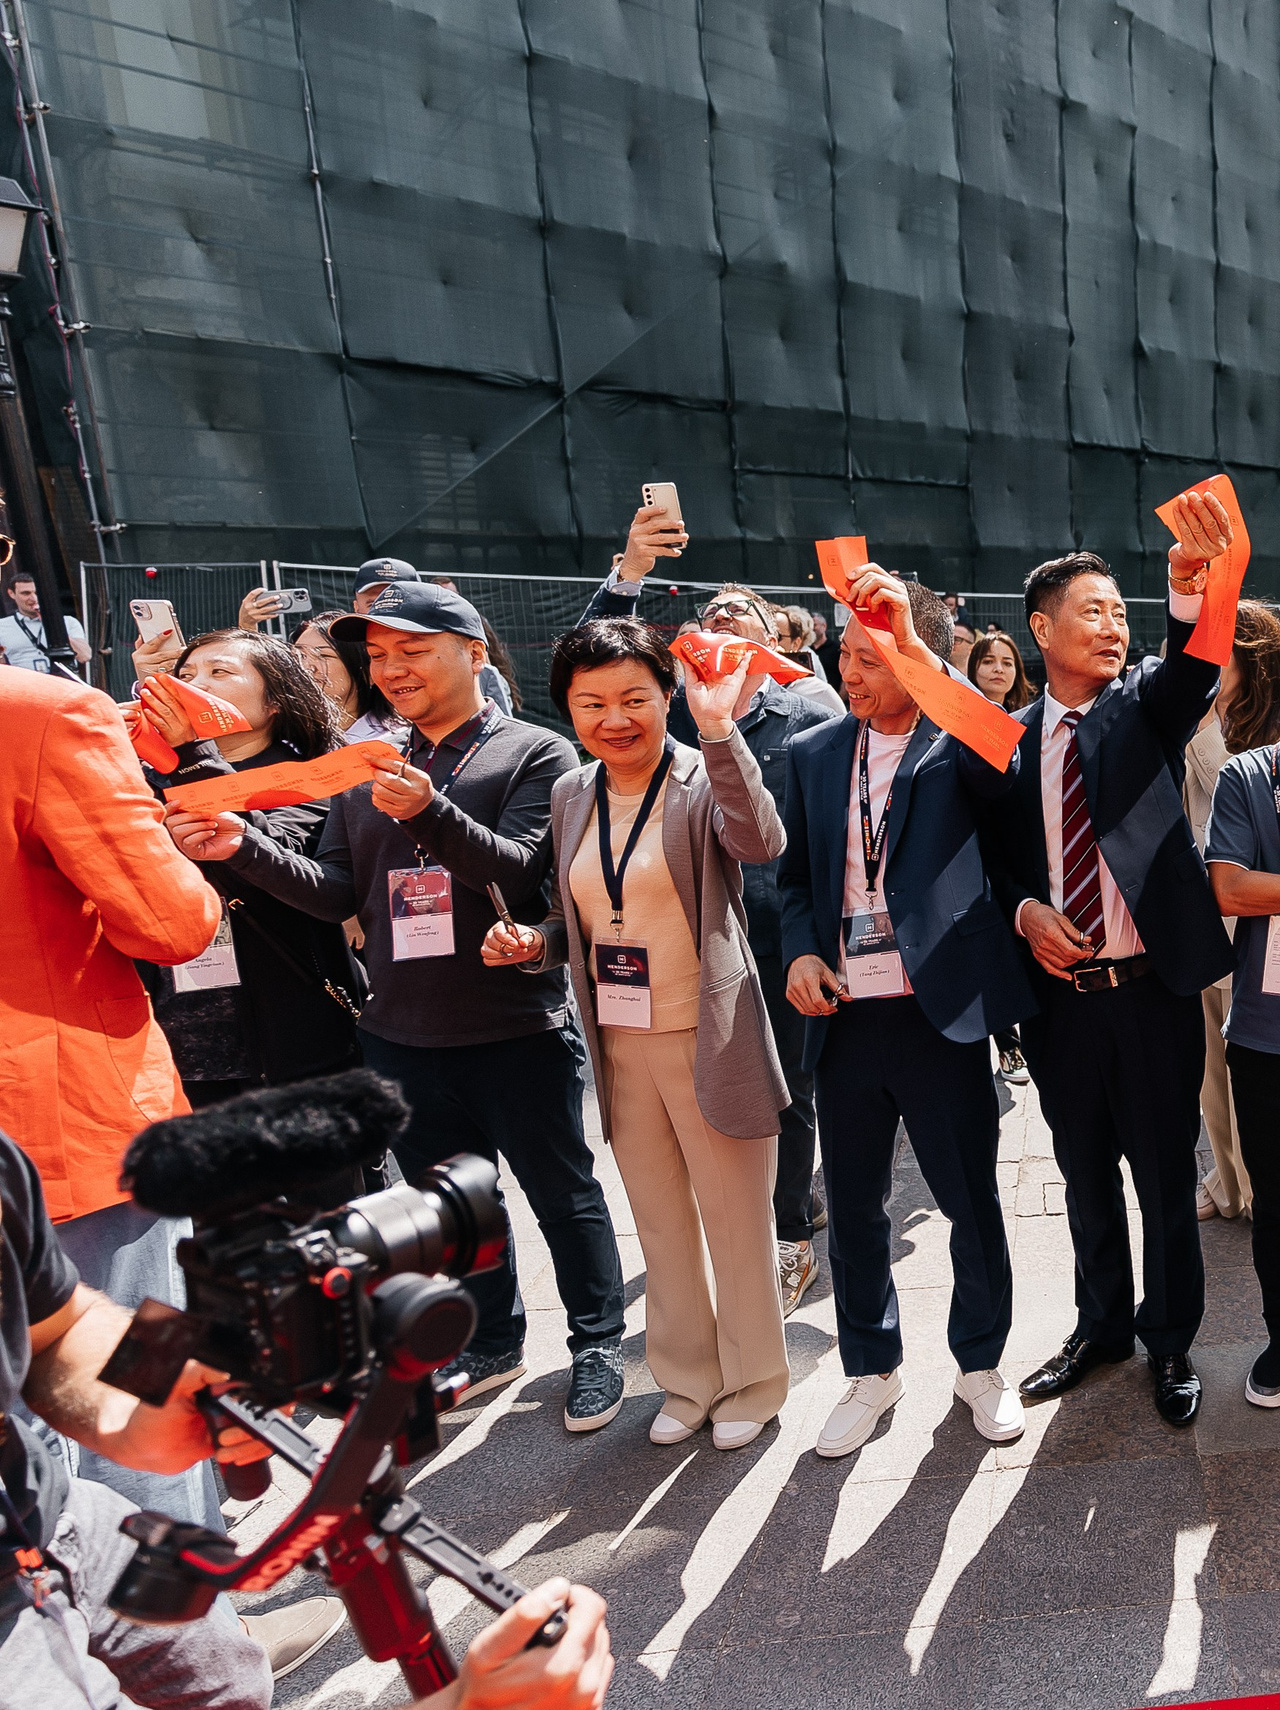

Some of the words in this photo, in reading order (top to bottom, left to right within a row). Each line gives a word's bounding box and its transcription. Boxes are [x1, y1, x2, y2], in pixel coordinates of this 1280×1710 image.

[874, 820, 887, 854] HENDERSON
[403, 893, 438, 902] HENDERSON
[855, 932, 887, 941] HENDERSON
